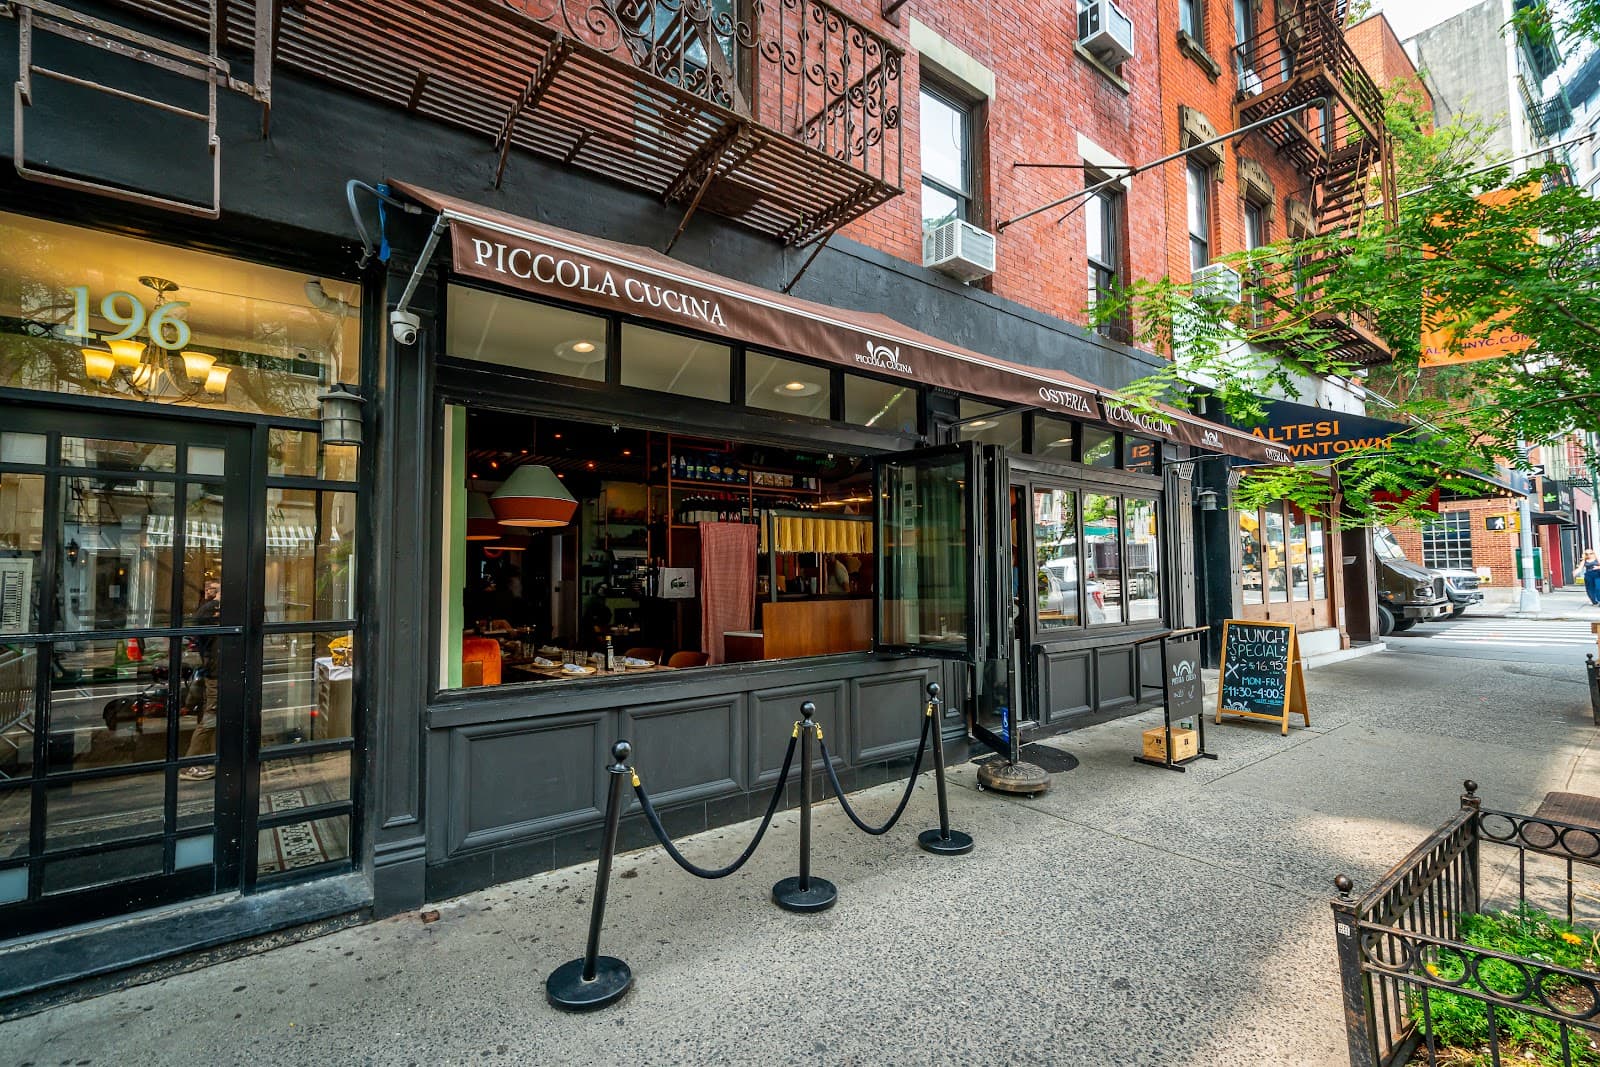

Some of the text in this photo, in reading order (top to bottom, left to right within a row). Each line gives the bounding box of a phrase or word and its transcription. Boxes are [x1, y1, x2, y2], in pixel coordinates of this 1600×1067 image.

[471, 237, 728, 328] PICCOLA CUCINA
[64, 284, 193, 351] 196
[855, 353, 913, 374] PICCOLA CUCINA
[1038, 387, 1092, 413] OSTERIA
[1251, 420, 1339, 442] ALTESI
[1288, 437, 1392, 457] WNTOWN
[1237, 628, 1285, 644] LUNCH
[1229, 642, 1282, 658] SPECIAL
[1241, 677, 1280, 687] MON-FRI
